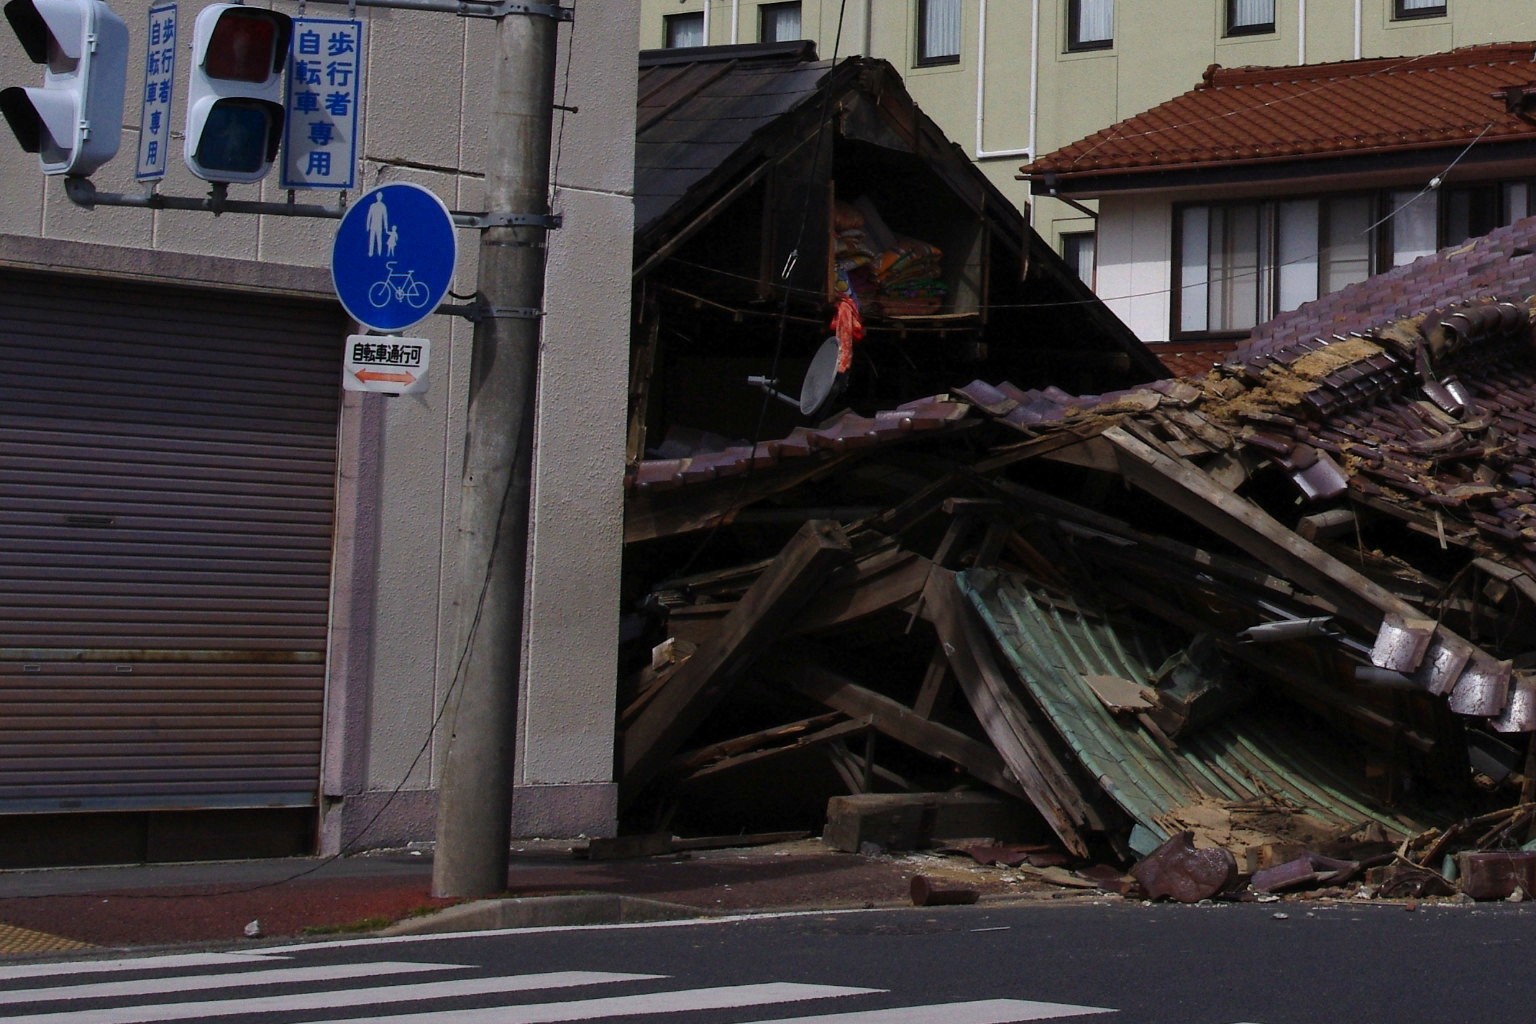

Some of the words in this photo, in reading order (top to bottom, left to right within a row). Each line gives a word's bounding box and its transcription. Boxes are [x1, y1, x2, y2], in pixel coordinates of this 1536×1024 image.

[146, 20, 161, 105] 自転車
[158, 18, 175, 104] 歩行者
[293, 30, 322, 114] 自転車
[325, 31, 355, 116] 歩行者
[145, 111, 162, 166] 専用
[305, 120, 335, 177] 専用
[352, 342, 423, 364] 自転車通行可
